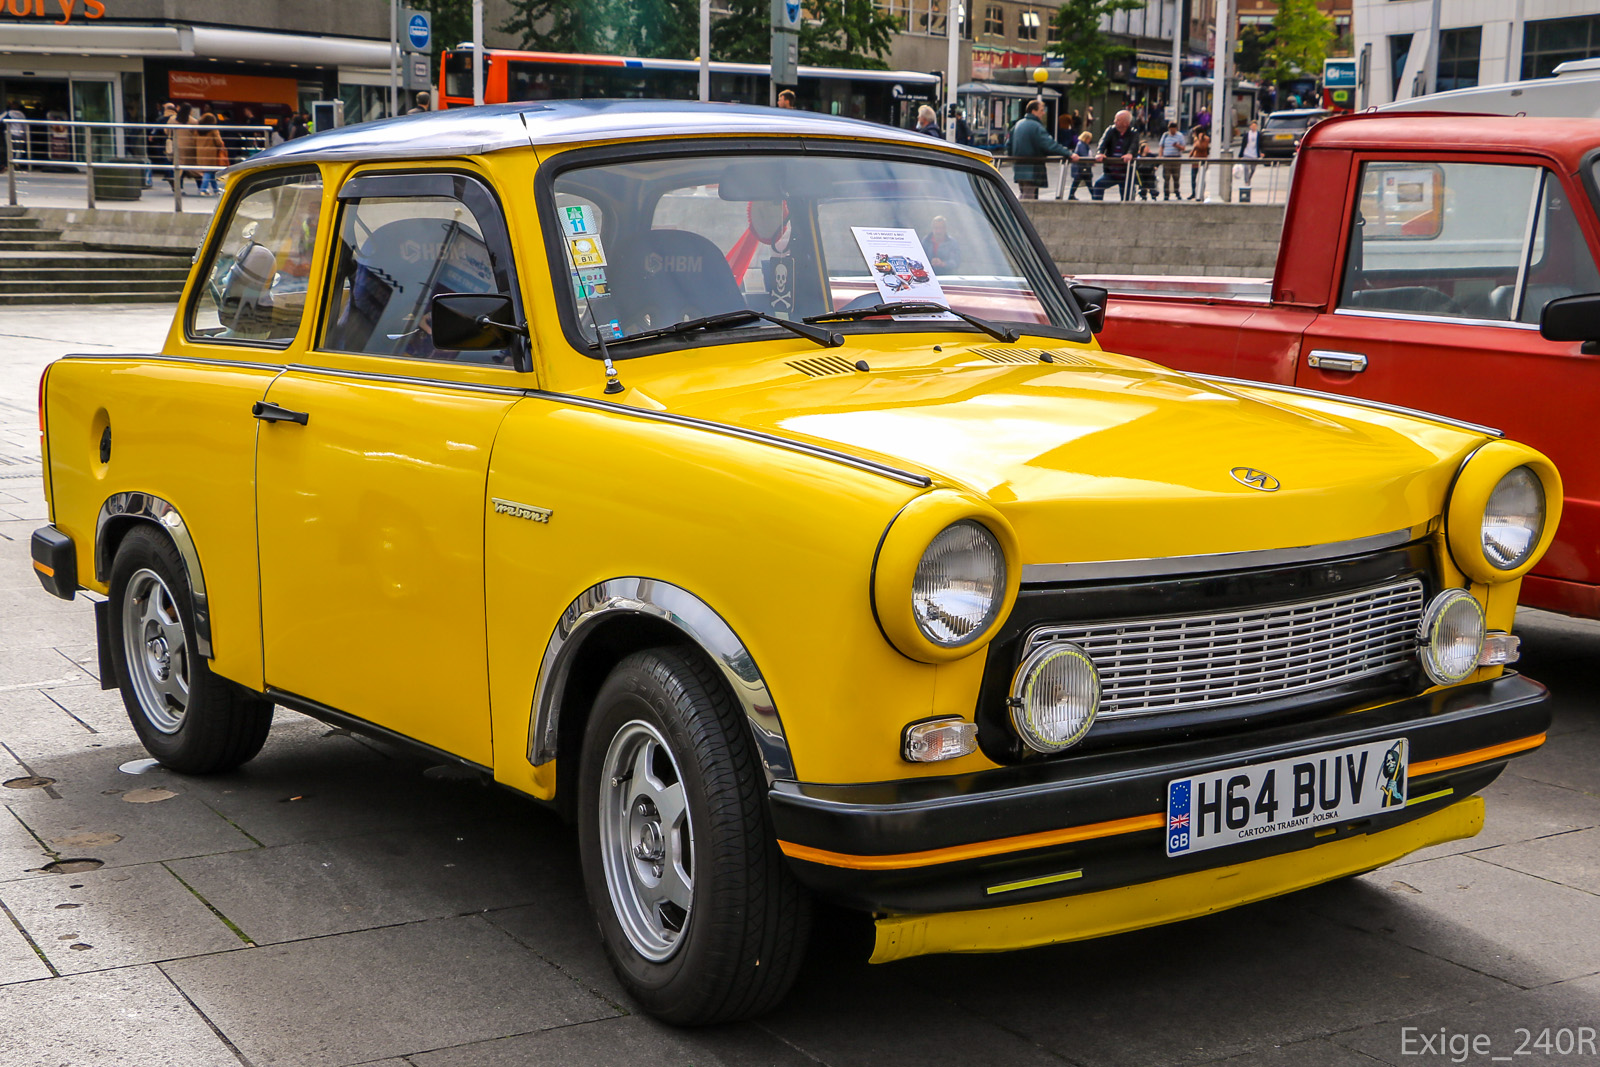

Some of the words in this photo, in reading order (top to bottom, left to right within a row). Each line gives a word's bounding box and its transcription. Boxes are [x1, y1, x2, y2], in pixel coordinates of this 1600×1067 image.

[570, 219, 586, 232] 11
[664, 255, 703, 273] HBM
[1197, 768, 1279, 838] H64
[1292, 751, 1369, 818] BUV
[1238, 824, 1276, 839] CARTOON
[1277, 816, 1309, 831] TRABANT
[1313, 811, 1339, 823] POLSKA
[1169, 833, 1188, 850] GB
